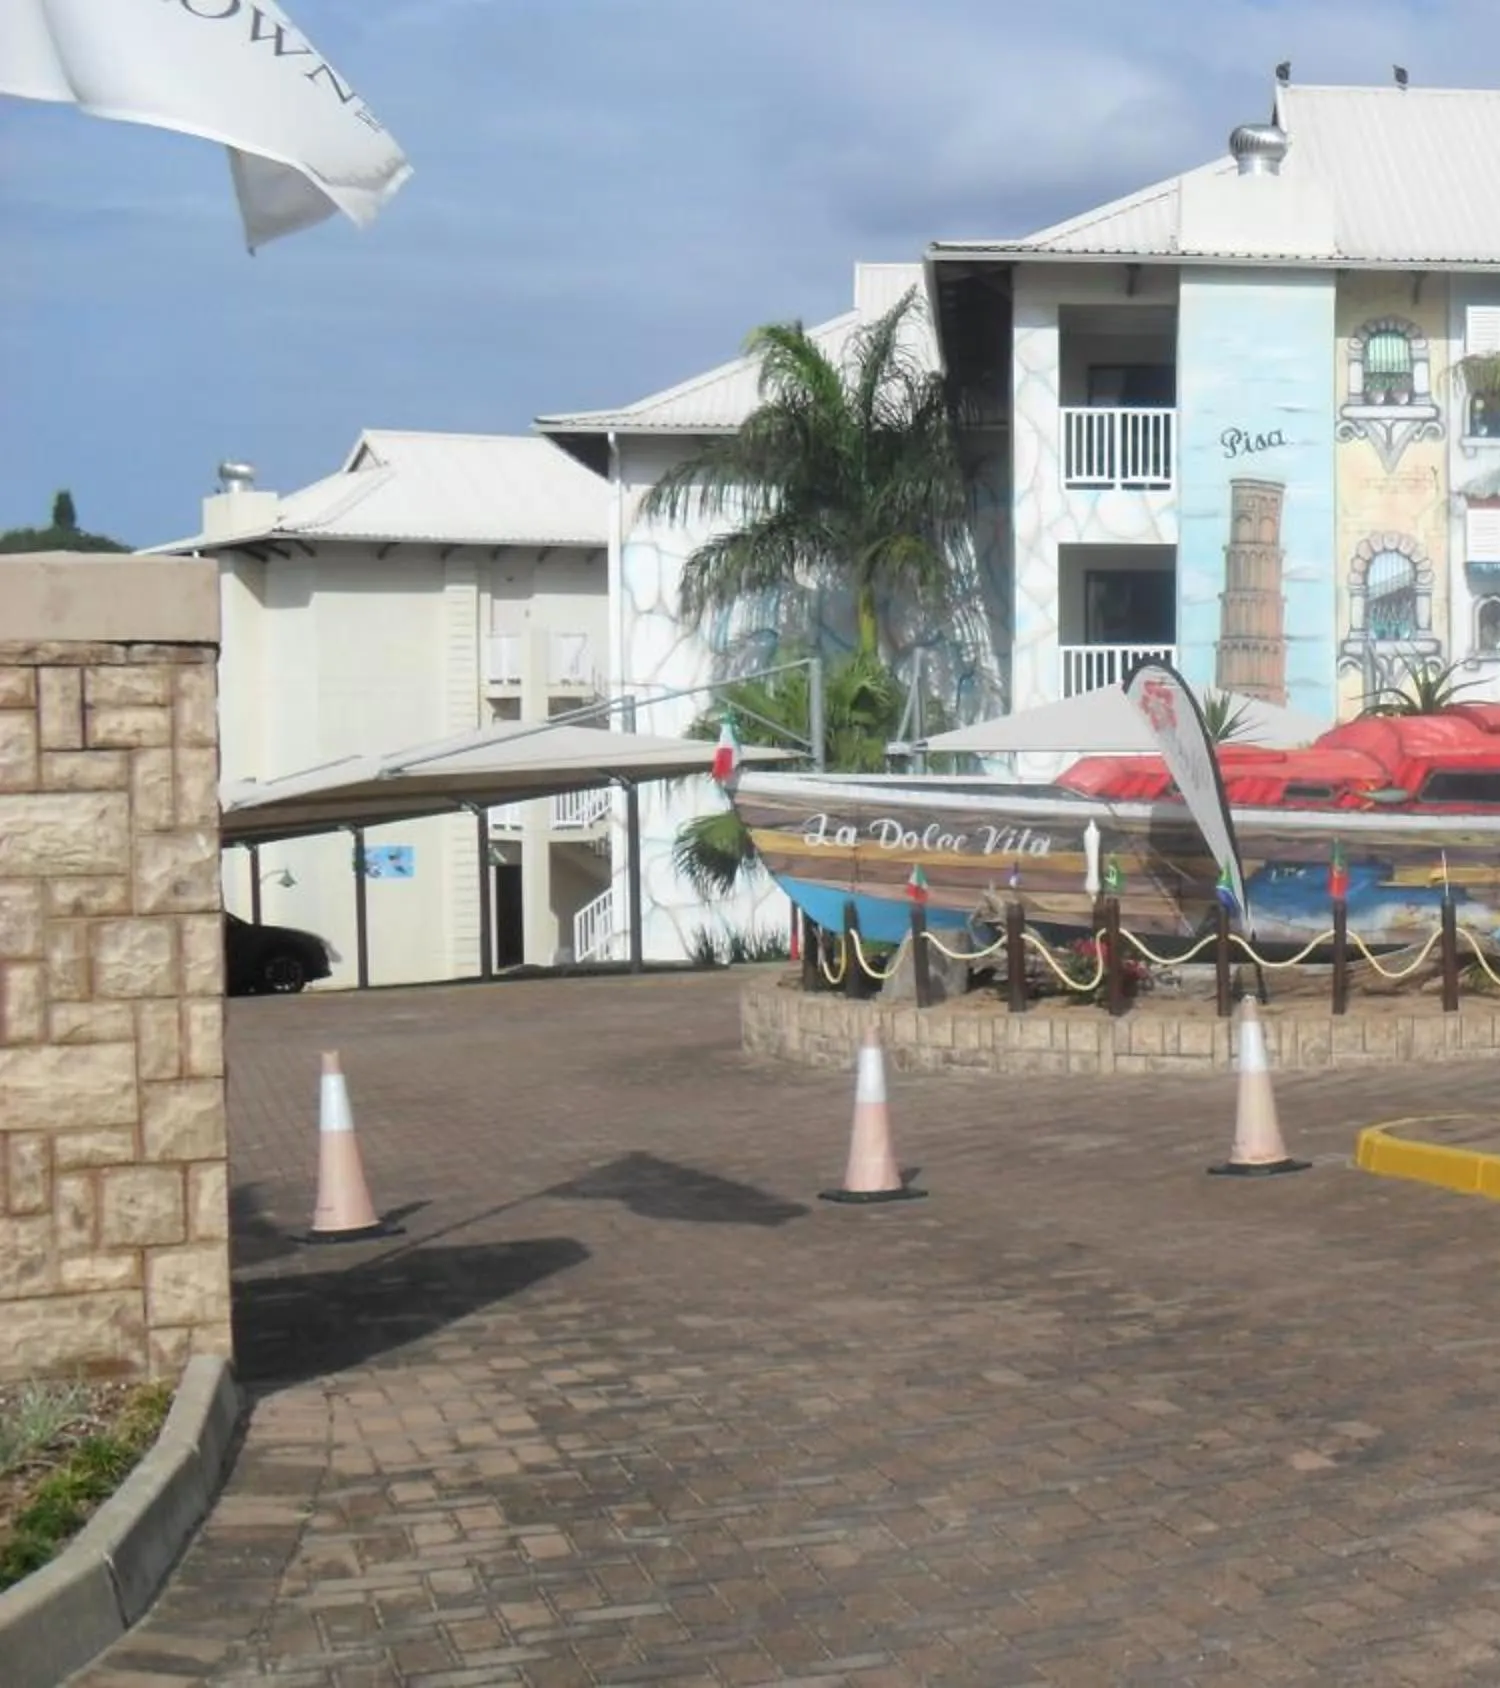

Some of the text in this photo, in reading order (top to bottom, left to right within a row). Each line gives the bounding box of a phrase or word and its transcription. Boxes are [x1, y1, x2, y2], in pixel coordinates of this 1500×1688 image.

[1221, 427, 1286, 458] Pisa
[802, 813, 1051, 858] La Dolce Vita
